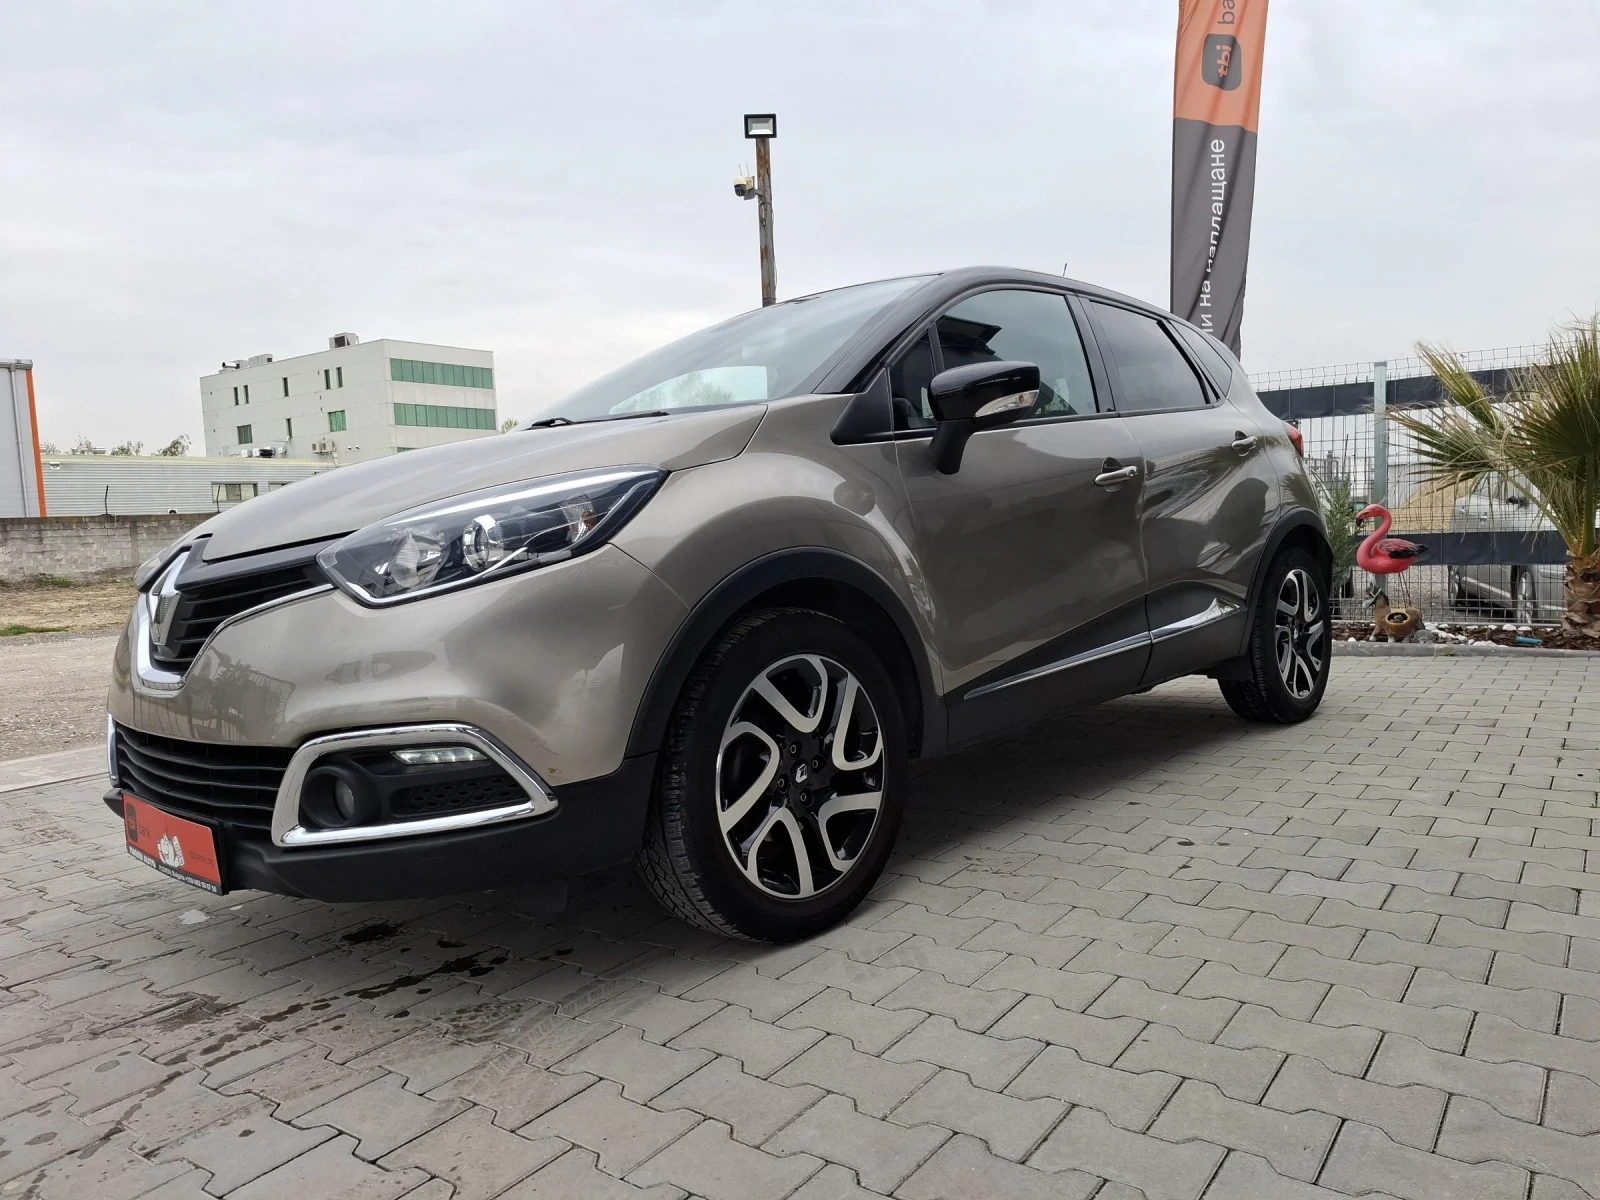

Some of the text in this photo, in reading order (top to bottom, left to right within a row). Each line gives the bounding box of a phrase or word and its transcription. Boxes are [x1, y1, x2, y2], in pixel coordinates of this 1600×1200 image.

[1216, 44, 1232, 78] tbi
[1199, 280, 1212, 307] на
[1206, 139, 1227, 272] изплащане
